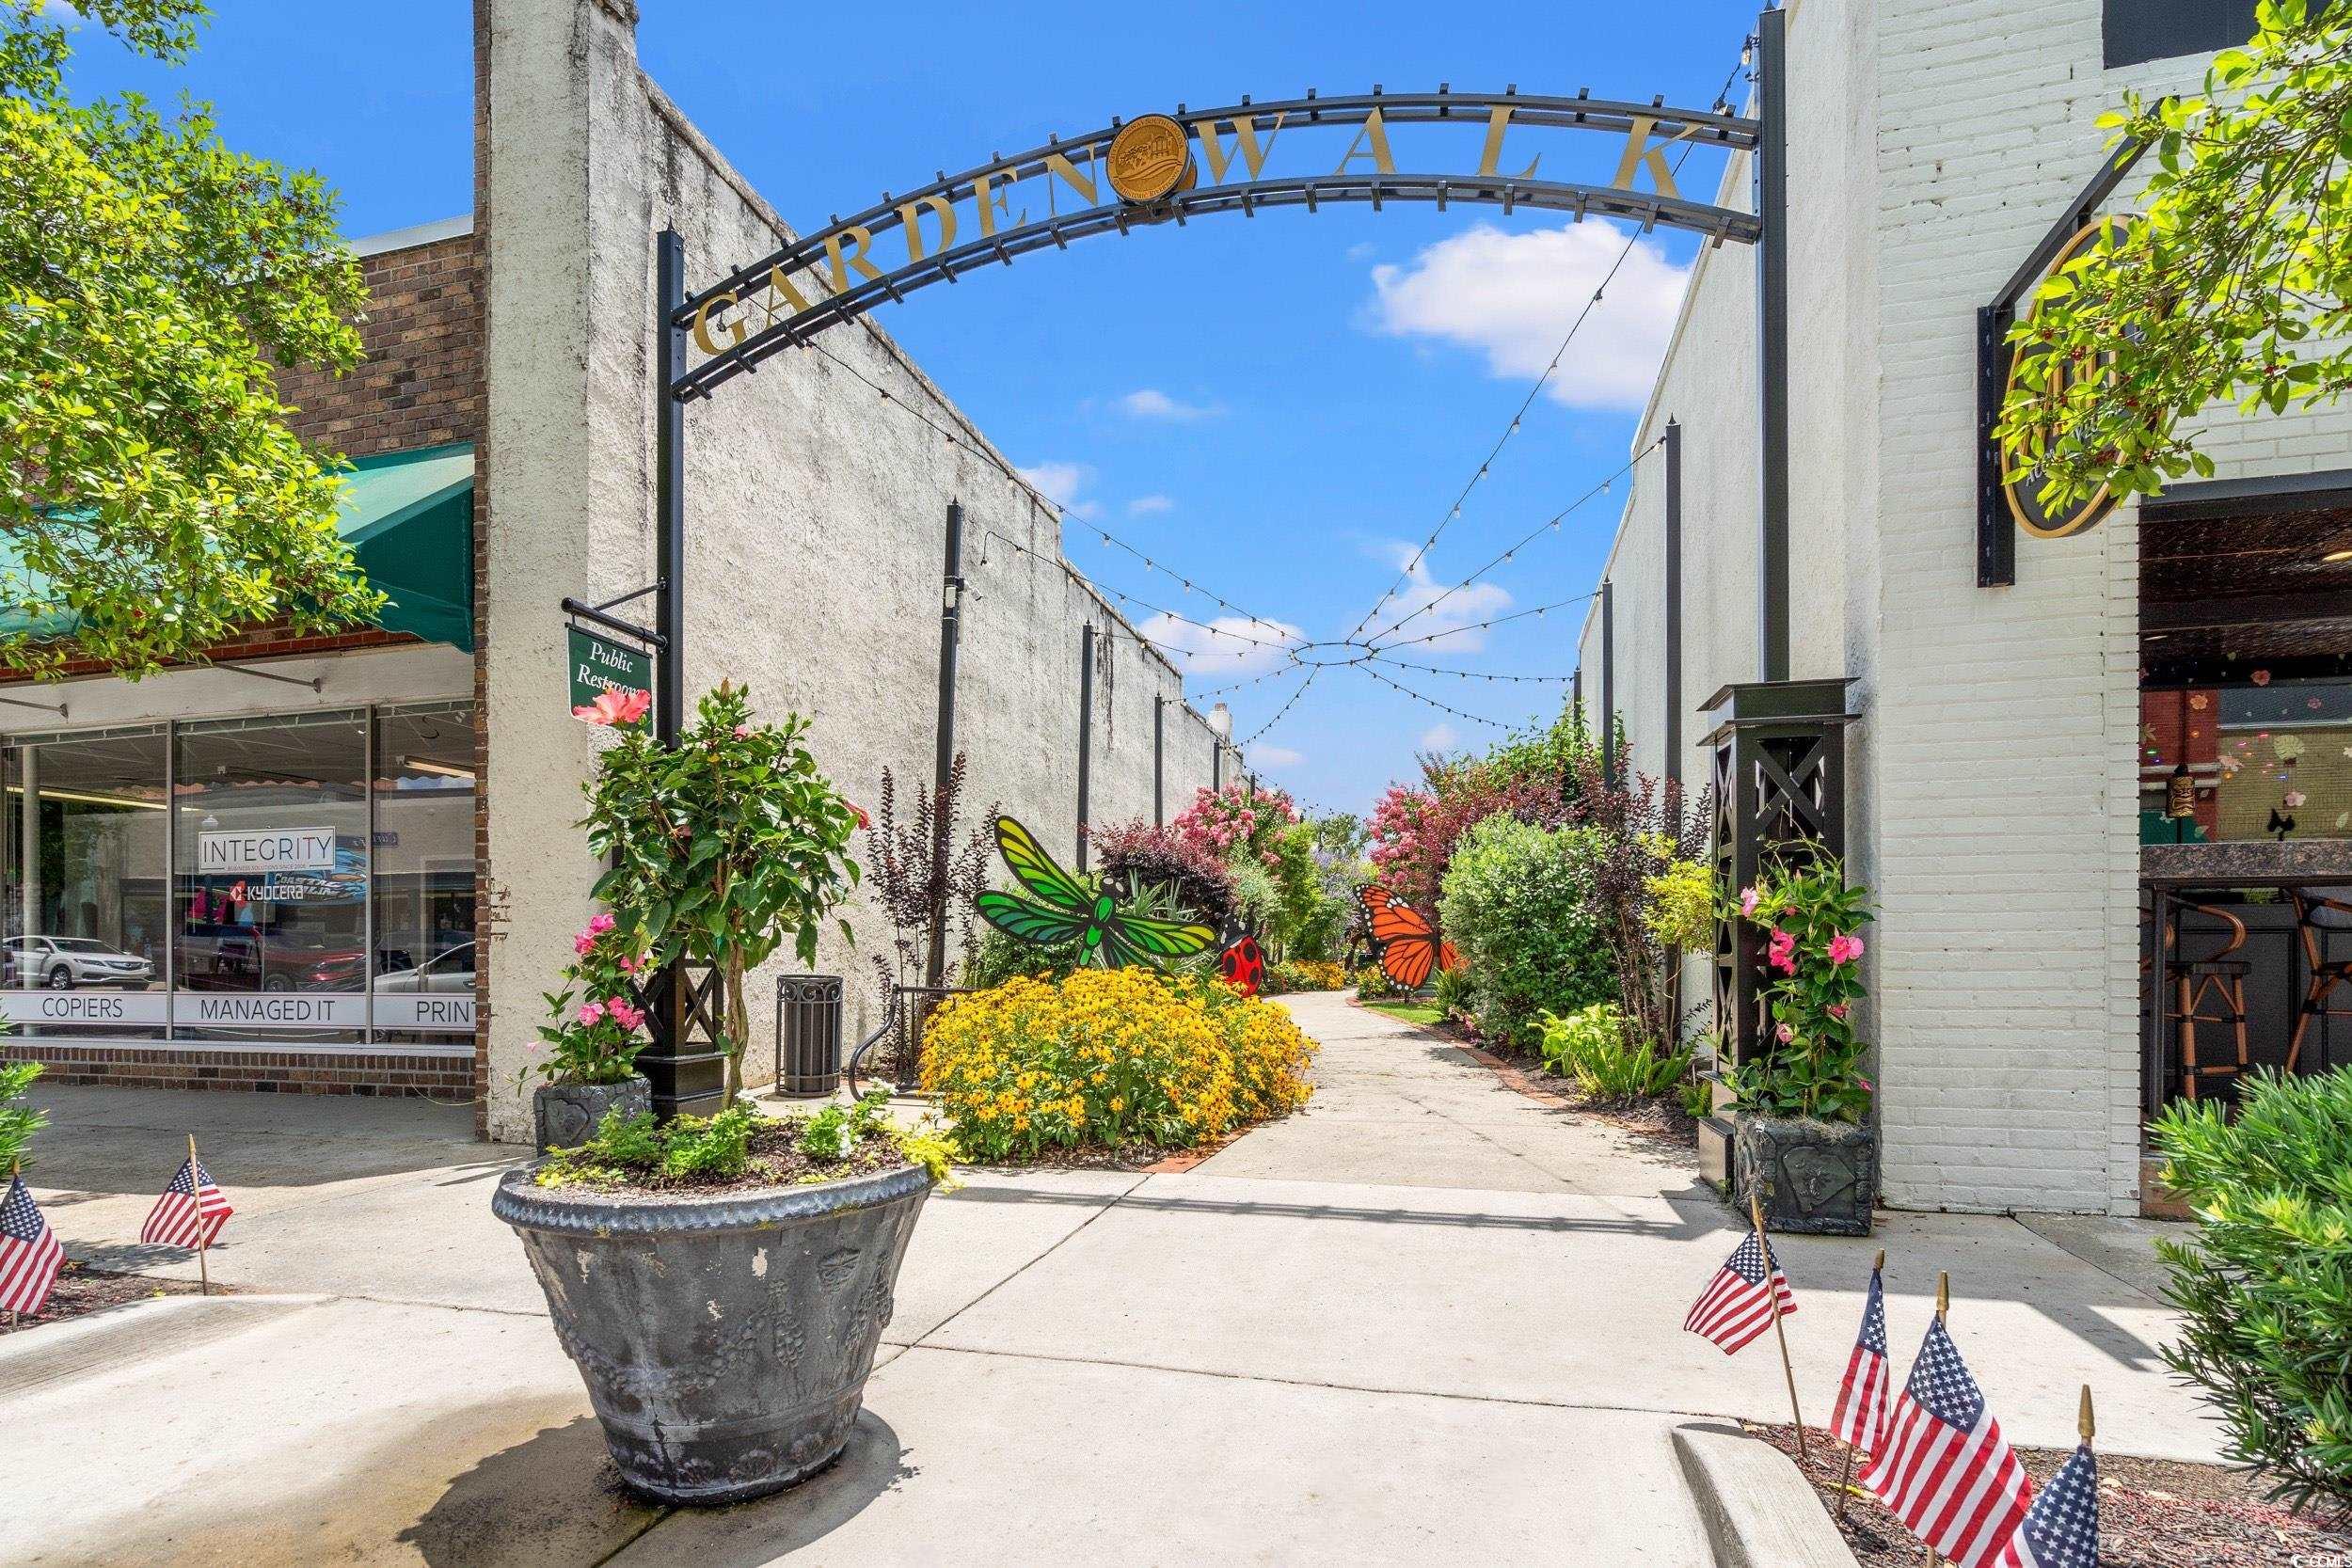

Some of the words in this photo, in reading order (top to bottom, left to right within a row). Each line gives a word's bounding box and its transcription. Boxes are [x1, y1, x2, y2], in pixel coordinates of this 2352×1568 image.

[693, 143, 1099, 356] GARDEN
[1192, 103, 1706, 199] WALK
[589, 641, 633, 673] Public
[204, 835, 332, 863] INTEGRITY
[246, 884, 304, 901] KYOCERA
[42, 997, 123, 1018] COPIERS
[200, 999, 311, 1021] MANAGED
[317, 1000, 336, 1021] IT
[417, 1001, 476, 1022] PRIN
